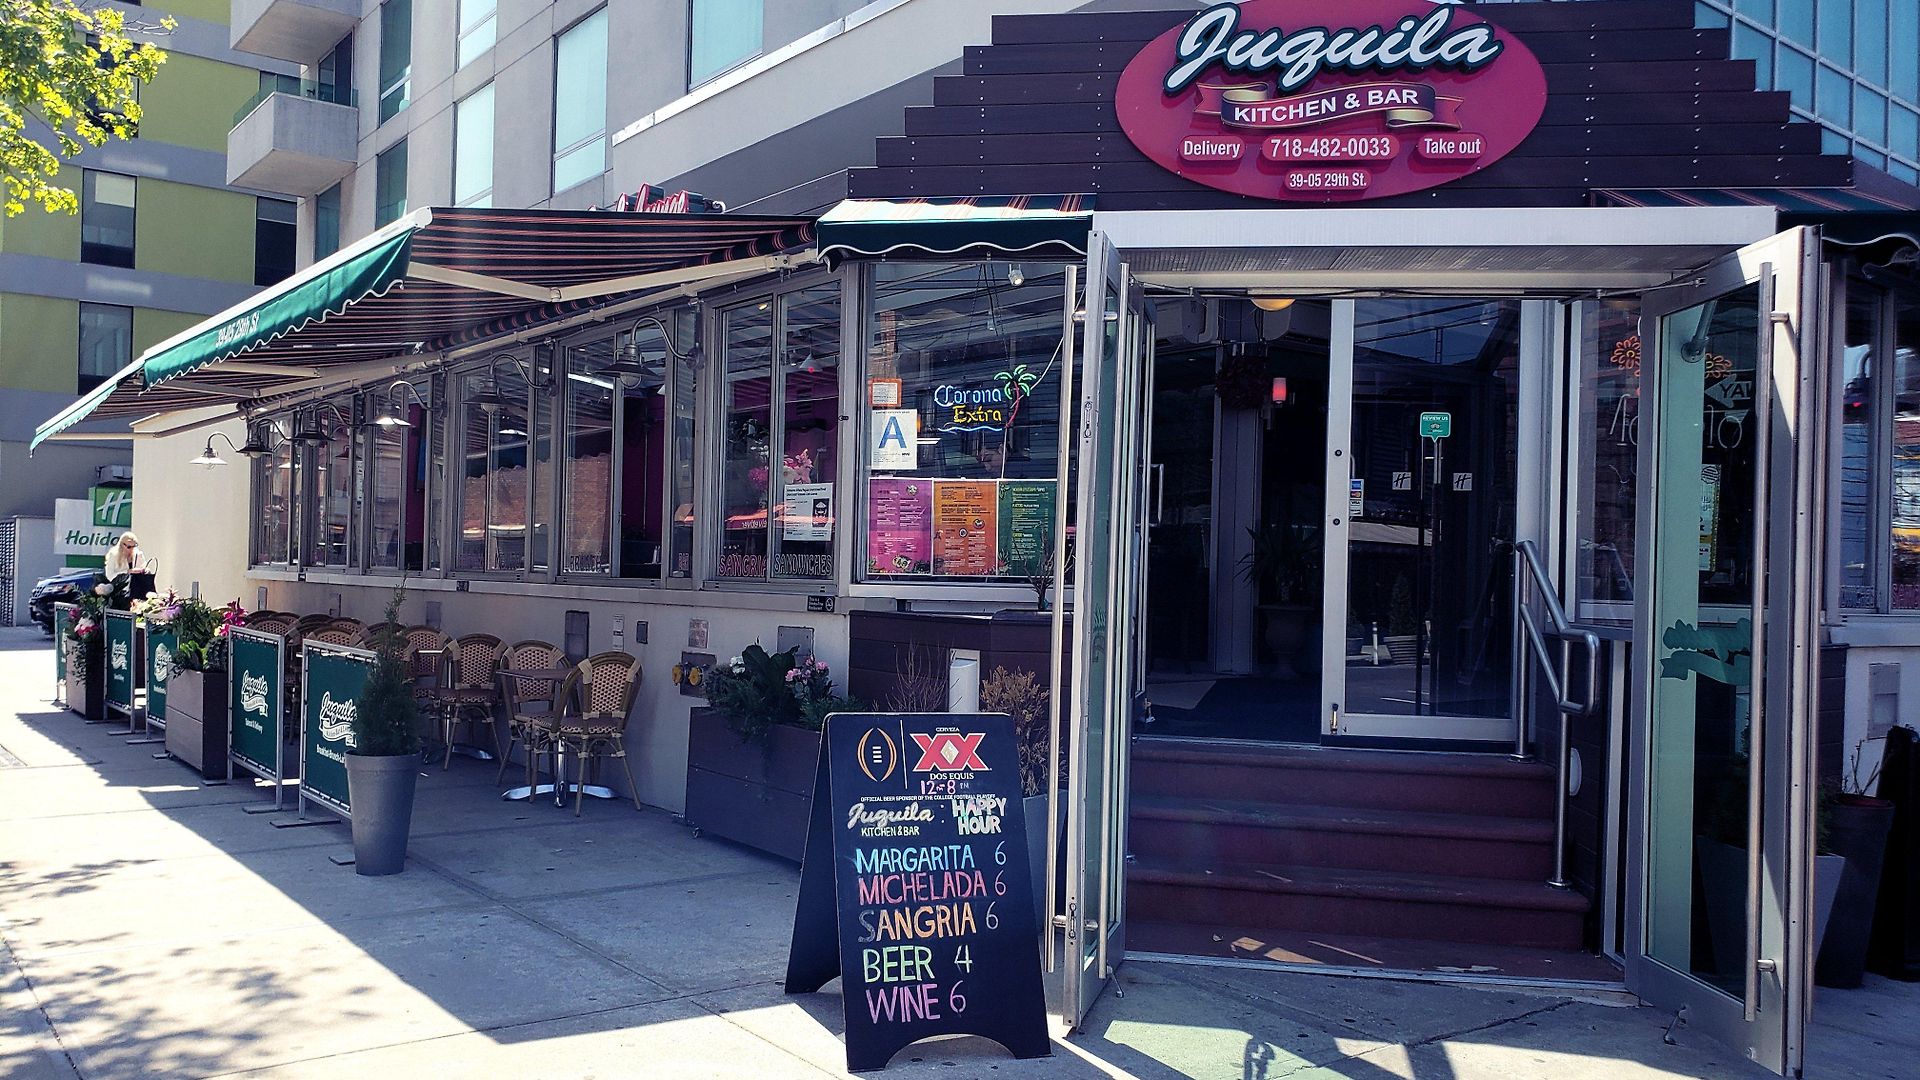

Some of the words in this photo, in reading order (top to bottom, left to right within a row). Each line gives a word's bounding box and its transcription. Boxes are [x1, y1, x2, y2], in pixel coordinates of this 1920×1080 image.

[1164, 2, 1503, 93] Juquila
[1234, 97, 1336, 123] KITCHEN
[1344, 92, 1361, 109] &
[1368, 88, 1419, 106] BAR
[1183, 140, 1241, 159] Delivery
[1270, 137, 1391, 158] 718-482-0033
[1424, 138, 1455, 154] Take
[1459, 138, 1481, 154] out
[1289, 173, 1322, 187] 39-05
[1324, 173, 1349, 187] 29th
[1352, 172, 1367, 187] St.
[934, 385, 1002, 407] Corona
[952, 404, 1002, 423] Extra
[878, 415, 907, 449] A
[65, 530, 121, 546] Holida
[774, 553, 833, 577] SANDWICHES
[909, 733, 989, 772] XX
[949, 772, 974, 780] EQUIS
[847, 801, 935, 829] Juquila
[951, 798, 1007, 818] HAPPY
[861, 826, 897, 837] KITCHEN
[903, 825, 920, 836] BAR
[957, 815, 1002, 835] HOUR
[854, 844, 975, 874] MARGARITA
[994, 841, 1007, 866] 6
[858, 870, 988, 906] MICHELADA
[994, 870, 1007, 896] 6
[858, 901, 977, 943] SANGRIA
[986, 901, 999, 930] 6
[863, 945, 936, 983] BEER
[954, 945, 973, 974] 4
[865, 984, 941, 1024] WINE
[950, 980, 967, 1014] 6
